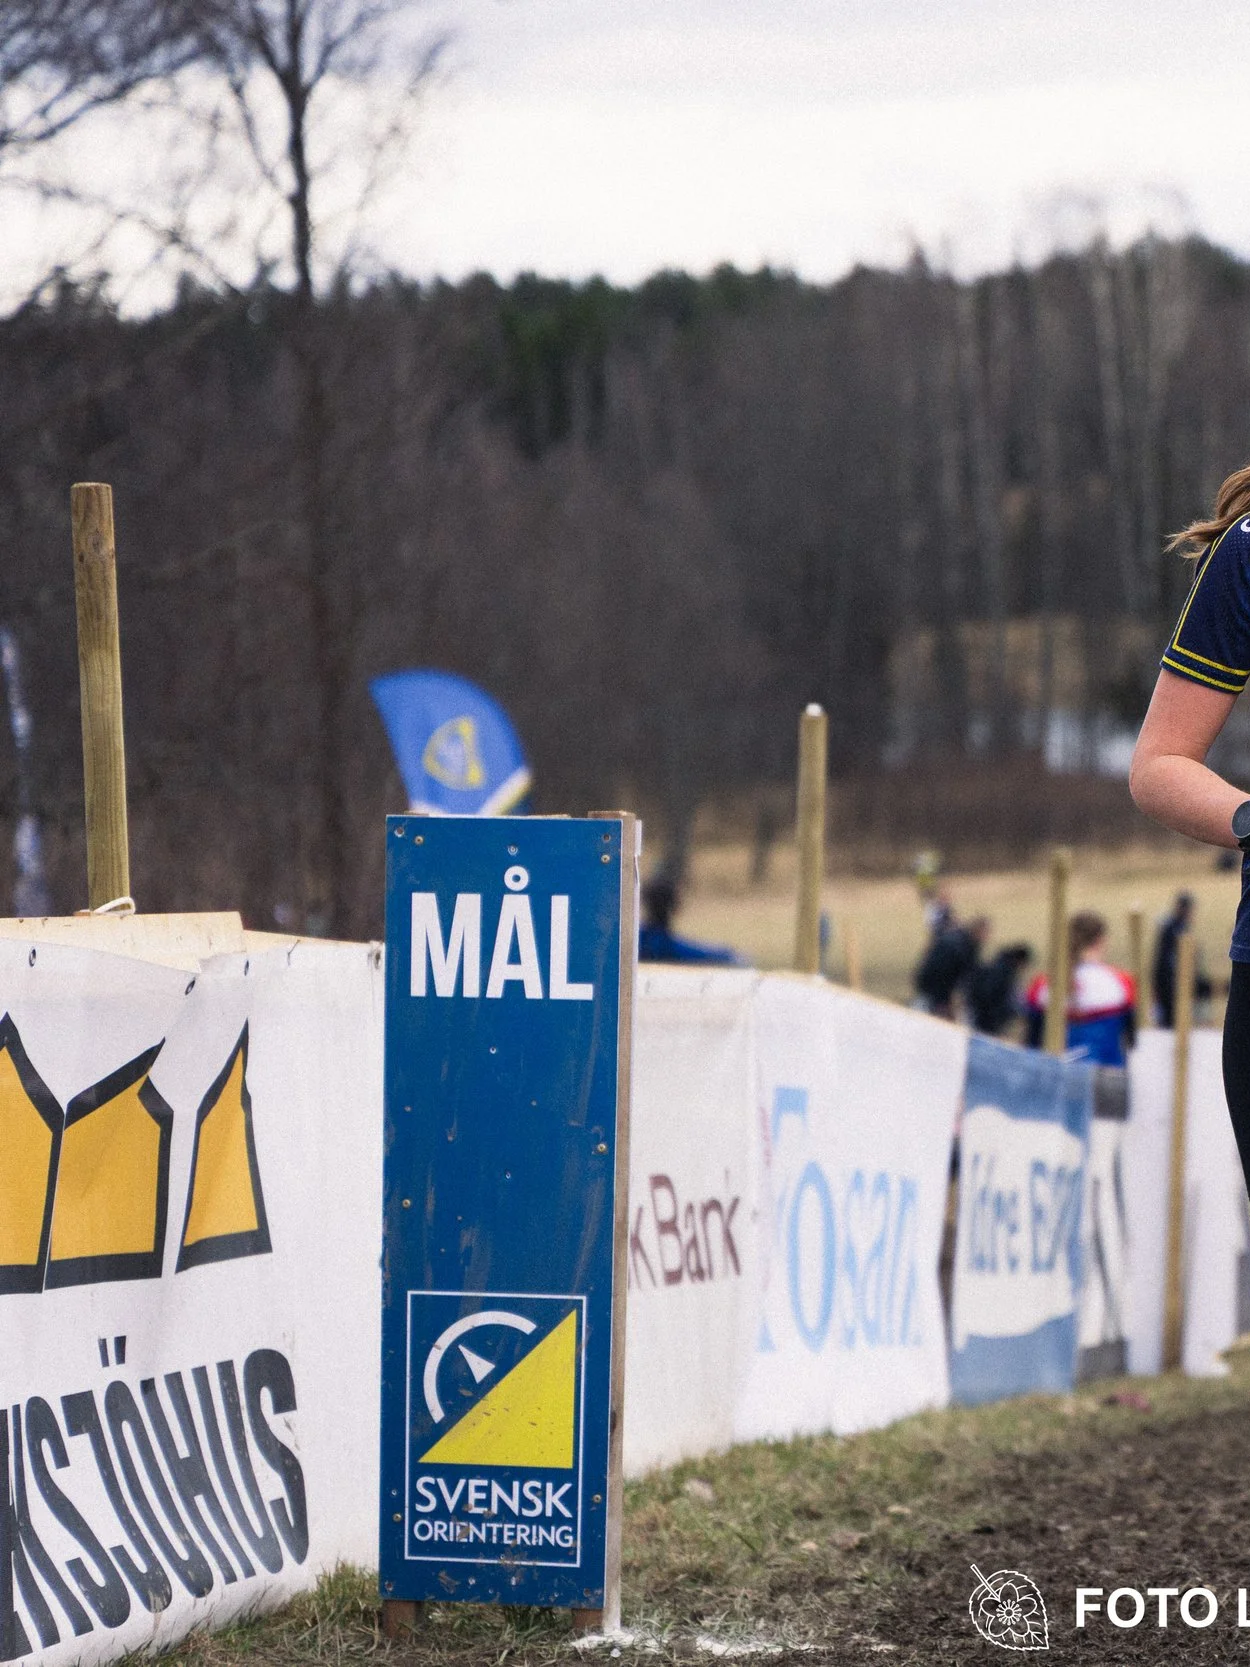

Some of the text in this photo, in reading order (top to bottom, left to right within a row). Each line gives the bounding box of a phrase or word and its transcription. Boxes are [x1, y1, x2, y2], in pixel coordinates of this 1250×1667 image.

[410, 865, 594, 1001] MÅL
[415, 1476, 573, 1518] SVENSK
[413, 1519, 574, 1548] ORIENTERING
